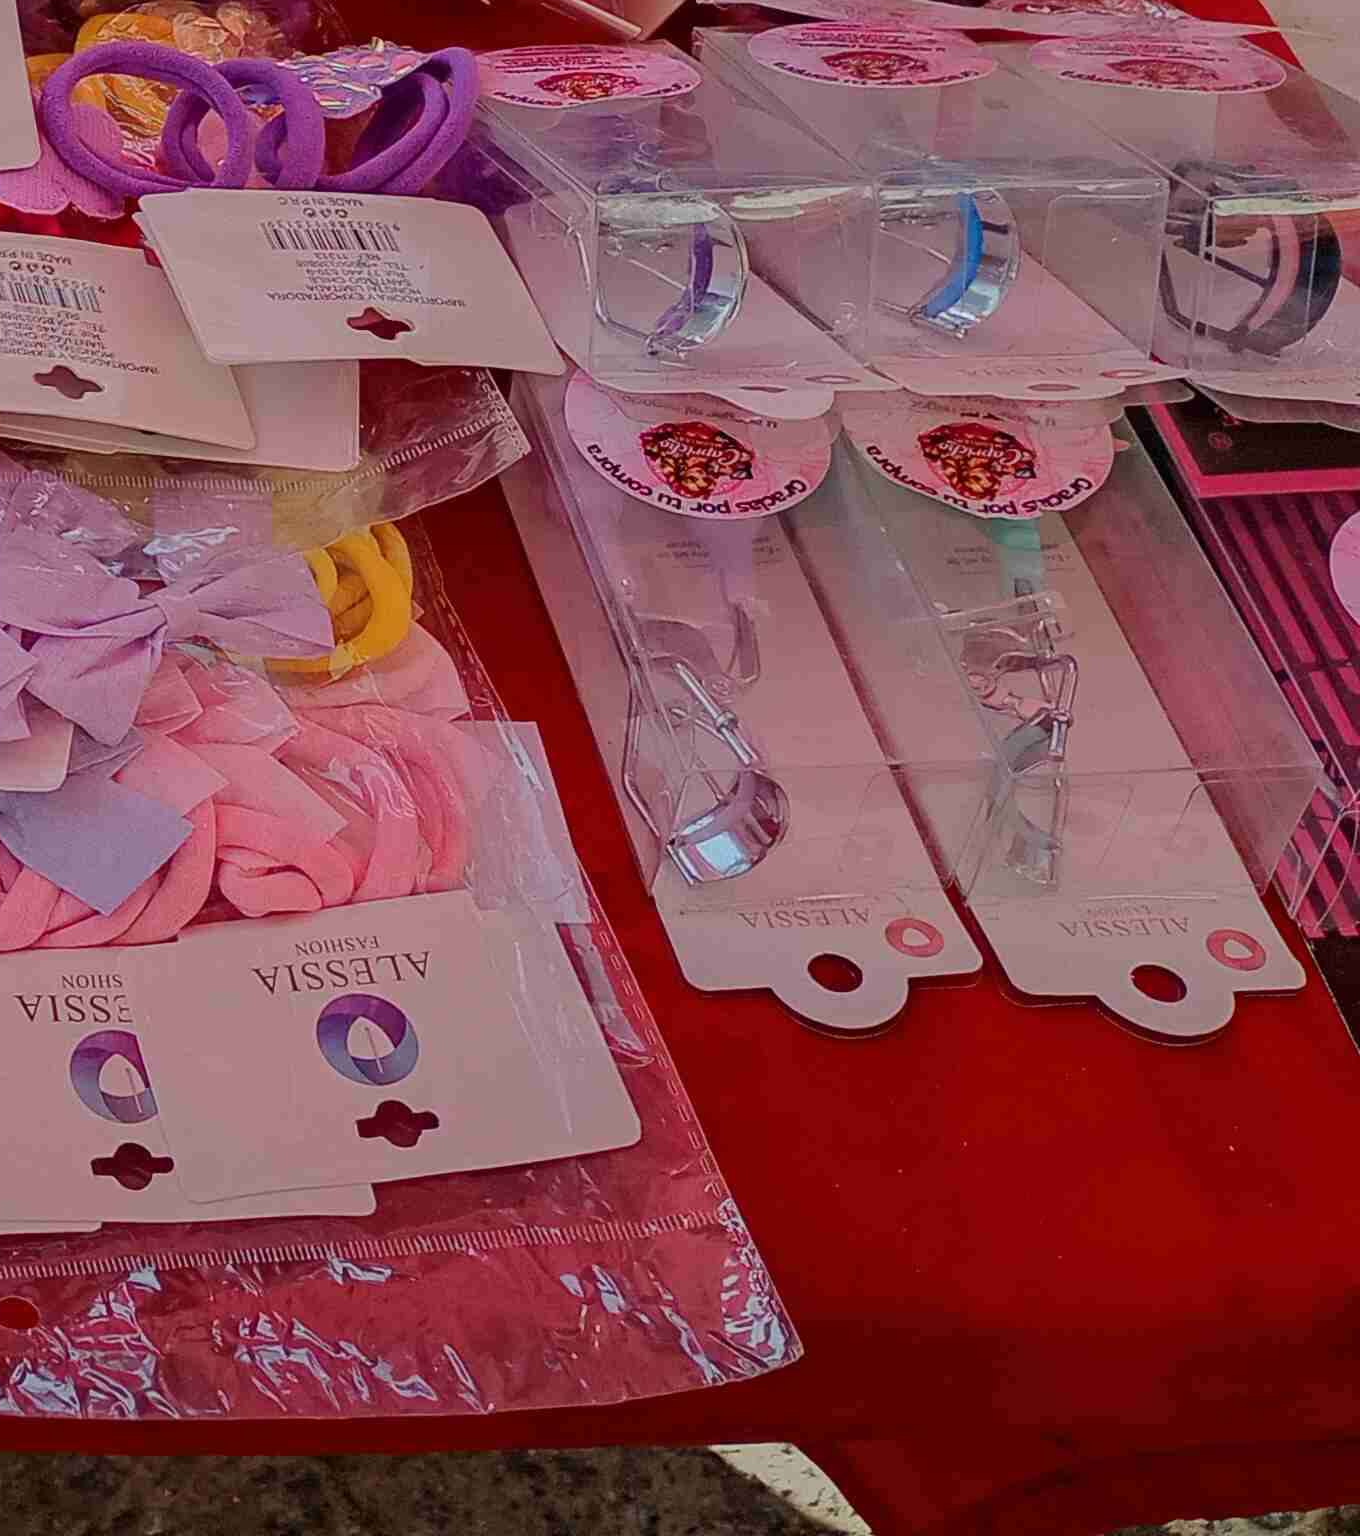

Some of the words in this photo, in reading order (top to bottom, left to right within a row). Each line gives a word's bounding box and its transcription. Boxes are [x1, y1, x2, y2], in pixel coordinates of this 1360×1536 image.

[659, 439, 739, 465] Capricho
[939, 440, 1018, 465] Capricho
[586, 443, 653, 497] compra
[866, 445, 938, 497] compra
[658, 493, 682, 510] tu
[734, 478, 807, 516] Gracias
[943, 495, 969, 510] tu
[1021, 477, 1093, 515] Gracias
[689, 502, 730, 515] por
[977, 502, 1019, 516] por
[738, 908, 871, 931] ALESSIA
[1059, 917, 1189, 939] ALESSIA
[294, 935, 379, 957] FASHION
[59, 973, 123, 991] SHION
[250, 949, 431, 996] ALESSIA
[13, 991, 131, 1025] ESSIA
